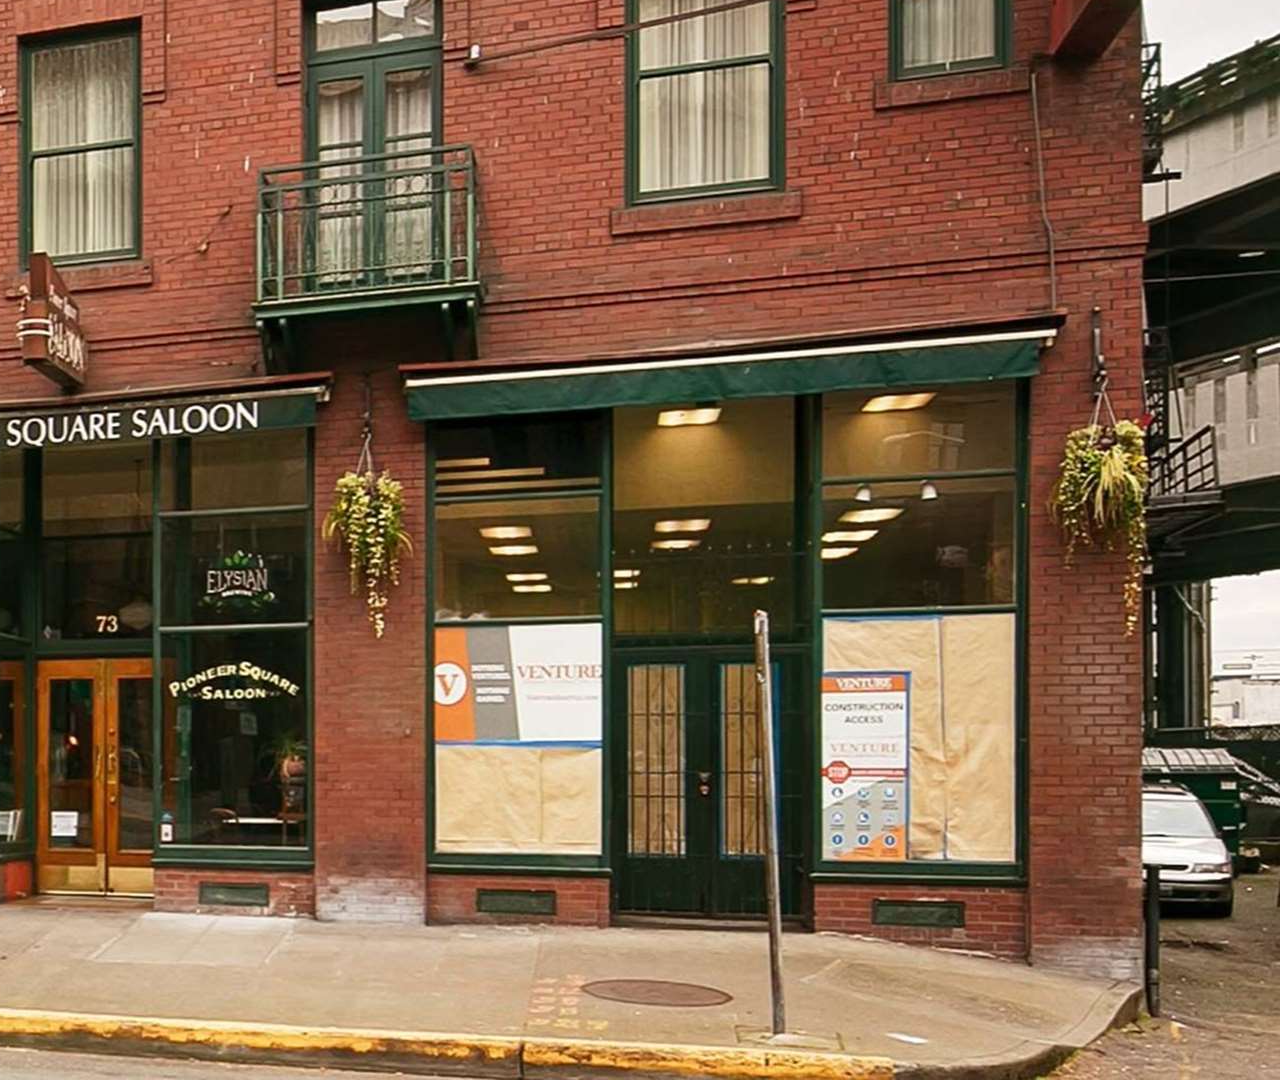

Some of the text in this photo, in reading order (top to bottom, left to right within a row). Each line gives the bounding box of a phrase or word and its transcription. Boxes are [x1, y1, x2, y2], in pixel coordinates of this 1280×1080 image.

[6, 412, 121, 447] SQUARE
[131, 401, 259, 438] SALOON
[207, 568, 268, 594] ELYSIAN
[96, 615, 119, 632] 73
[517, 664, 602, 679] VENTURE
[436, 674, 458, 697] V
[824, 703, 904, 712] CONSTRUCTION
[844, 715, 883, 724] ACCESS
